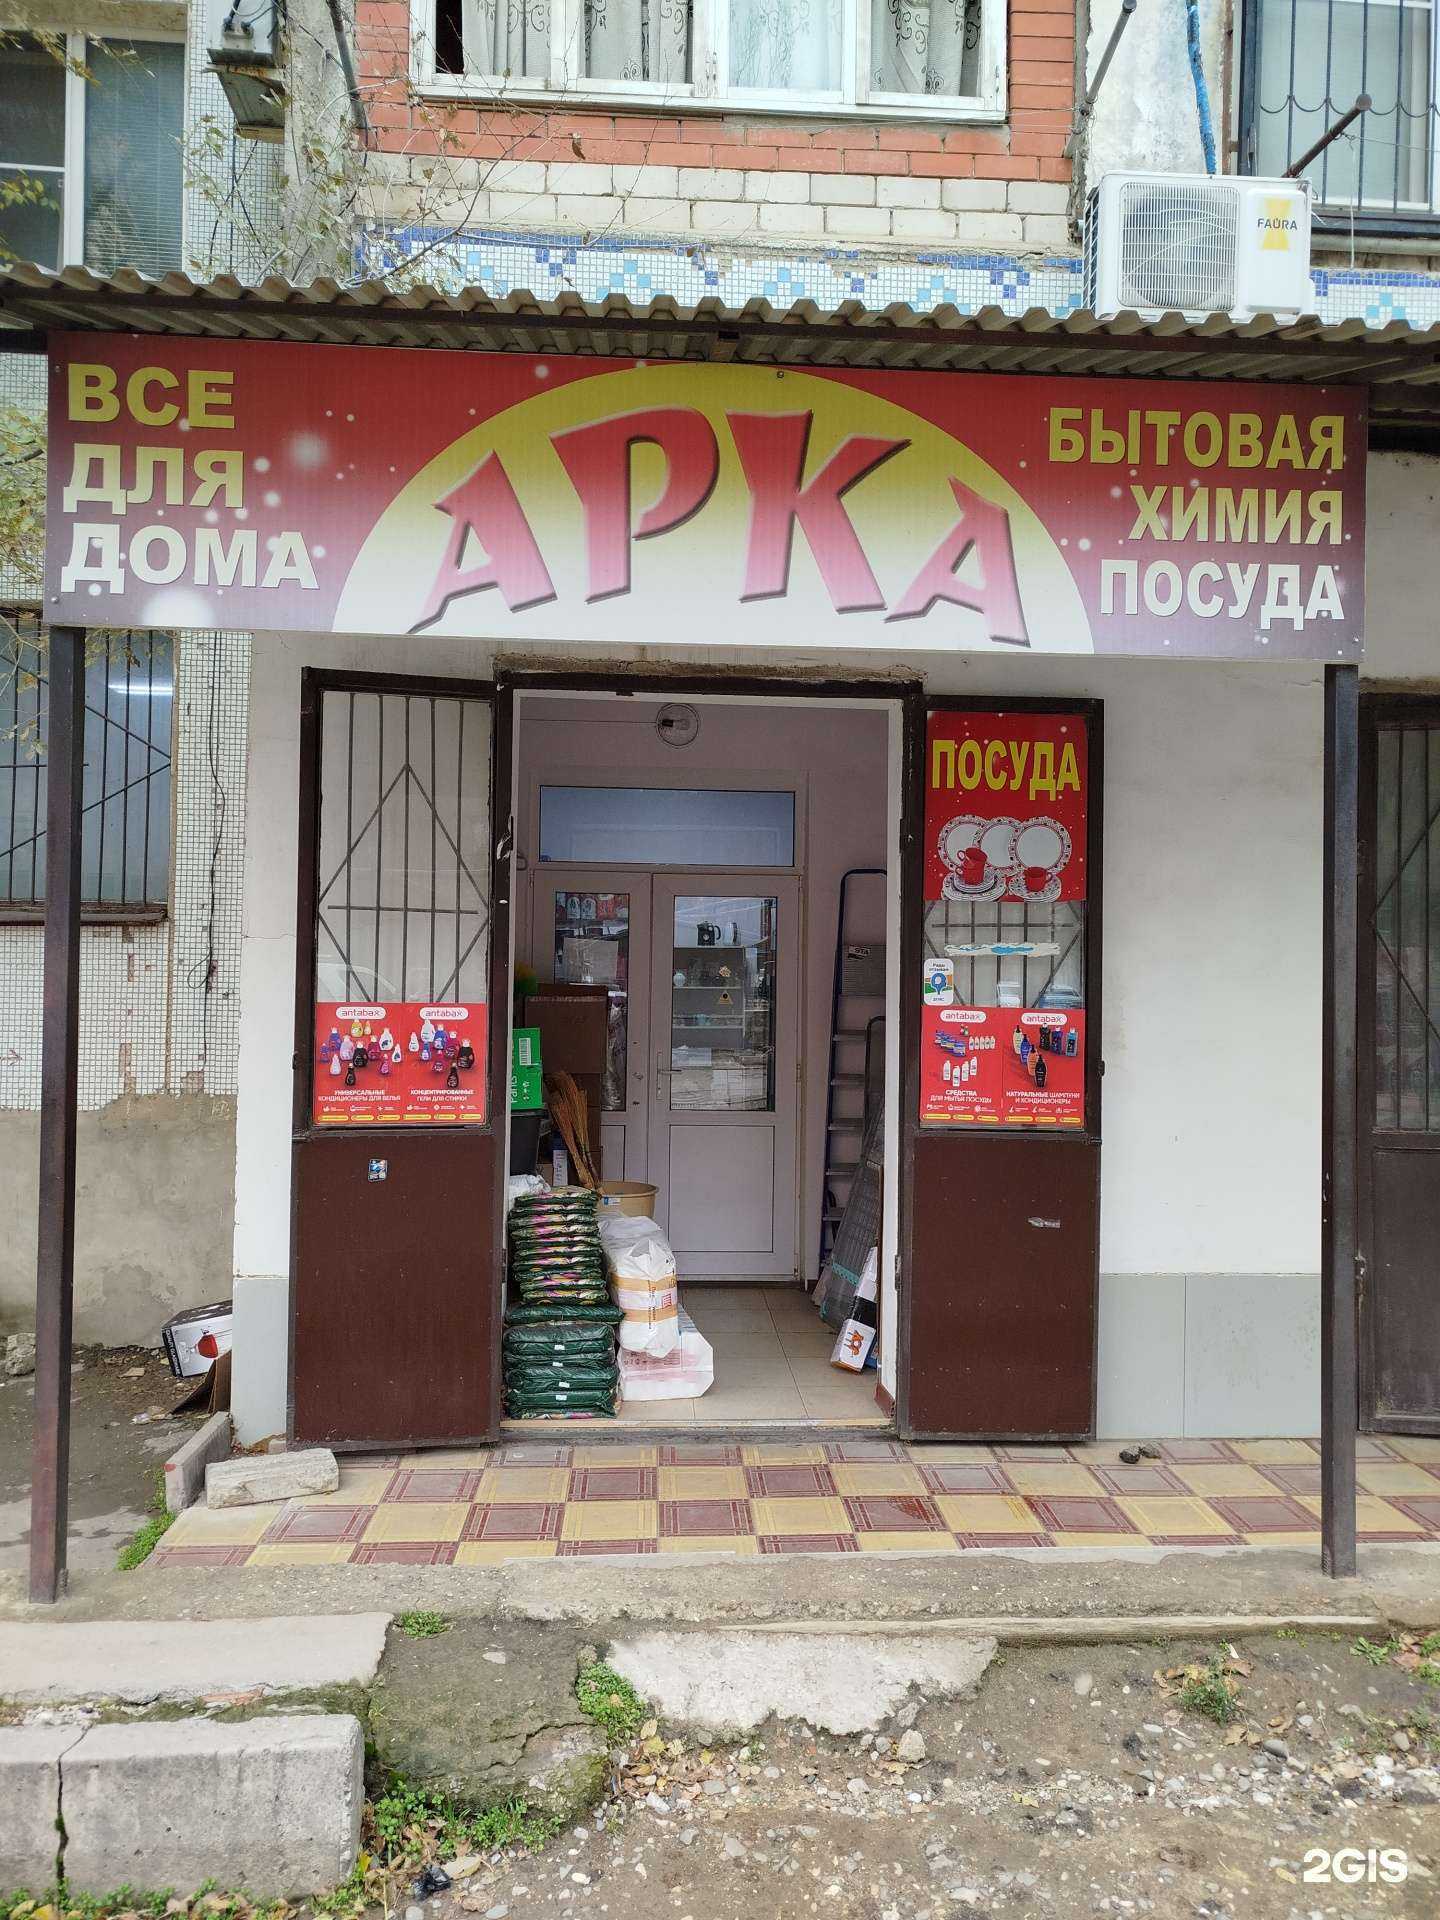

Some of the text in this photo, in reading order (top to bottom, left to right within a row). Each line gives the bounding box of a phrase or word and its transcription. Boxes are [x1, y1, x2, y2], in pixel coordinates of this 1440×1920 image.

[67, 363, 236, 430] ВСЕ
[1048, 407, 1346, 470] БЫТОВАЯ
[63, 443, 245, 516] ДЛЯ
[406, 405, 1031, 648] АРКА
[1127, 484, 1344, 546] ХИМИЯ
[60, 522, 321, 595] ДОМА
[1099, 558, 1346, 631] ПОСУДА
[932, 739, 1081, 801] ПОСУДА
[341, 1008, 381, 1018] antabax
[425, 1008, 463, 1018] antabax
[945, 1011, 981, 1021] antabax
[1026, 1014, 1063, 1024] antabax
